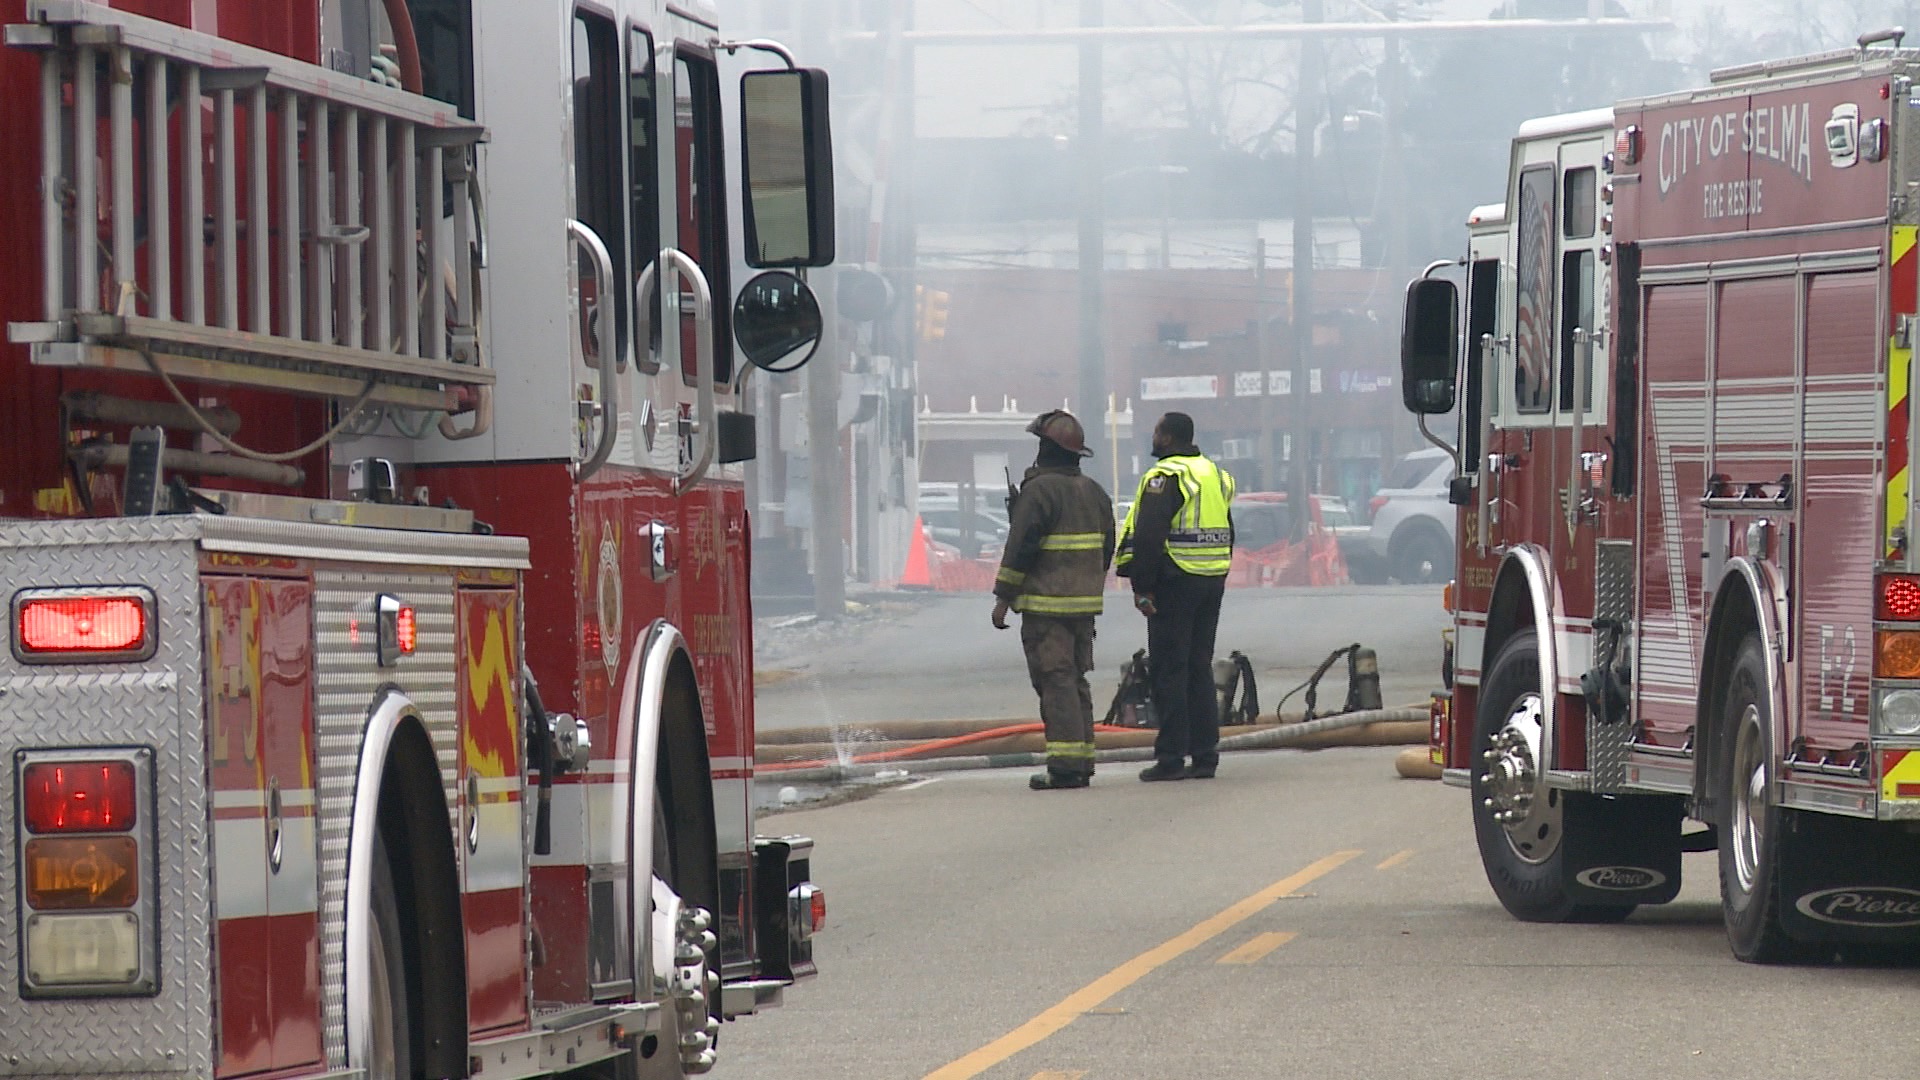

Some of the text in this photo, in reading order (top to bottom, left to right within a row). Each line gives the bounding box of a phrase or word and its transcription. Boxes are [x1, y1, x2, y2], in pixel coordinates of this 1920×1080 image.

[1659, 102, 1812, 194] CITY OF SELMA
[1703, 178, 1763, 218] FIRE RESCUE
[1821, 624, 1855, 713] E-2
[1826, 893, 1920, 914] Pierce
